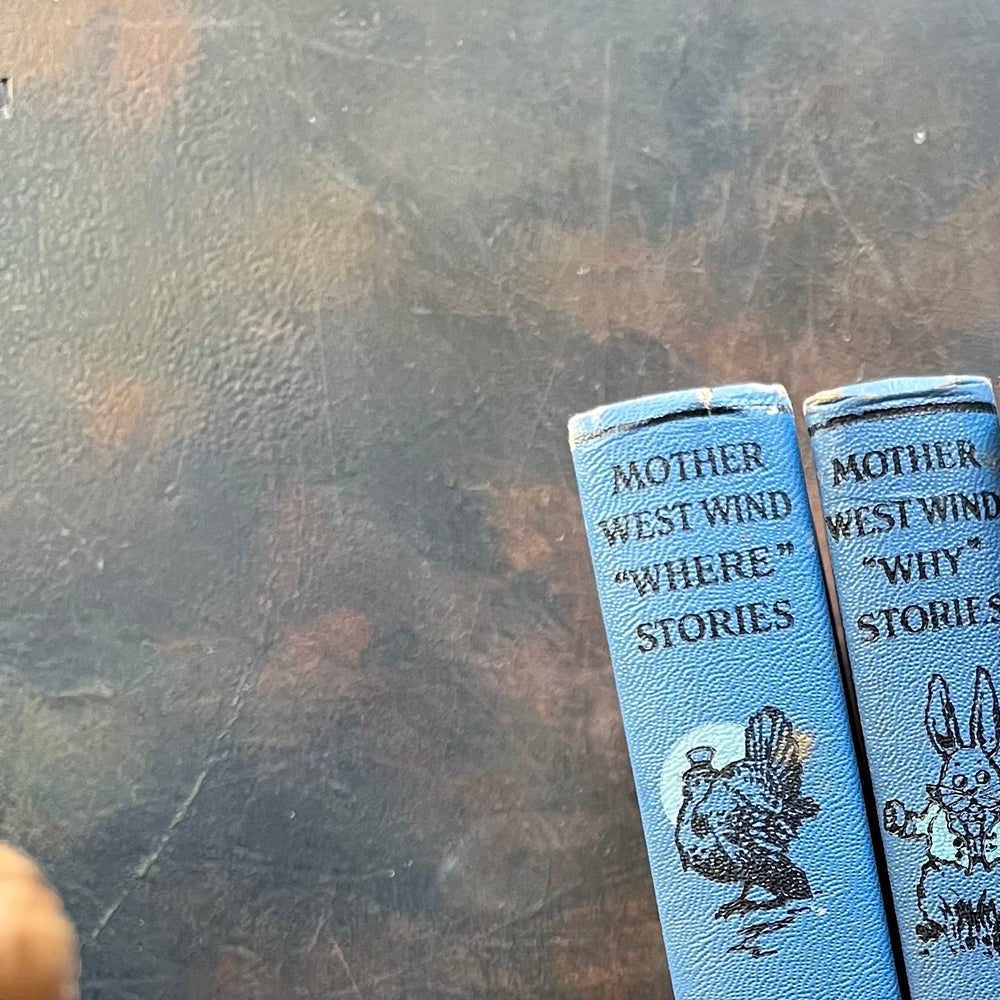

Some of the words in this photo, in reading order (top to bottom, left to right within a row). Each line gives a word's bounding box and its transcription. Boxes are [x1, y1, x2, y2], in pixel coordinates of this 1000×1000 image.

[612, 442, 767, 496] MOTHER
[830, 439, 981, 487] MOTHER
[598, 502, 693, 548] WEST
[700, 491, 792, 527] WIND
[825, 498, 912, 543] WEST
[614, 541, 795, 598] “WHERE”
[636, 600, 795, 653] STORIES
